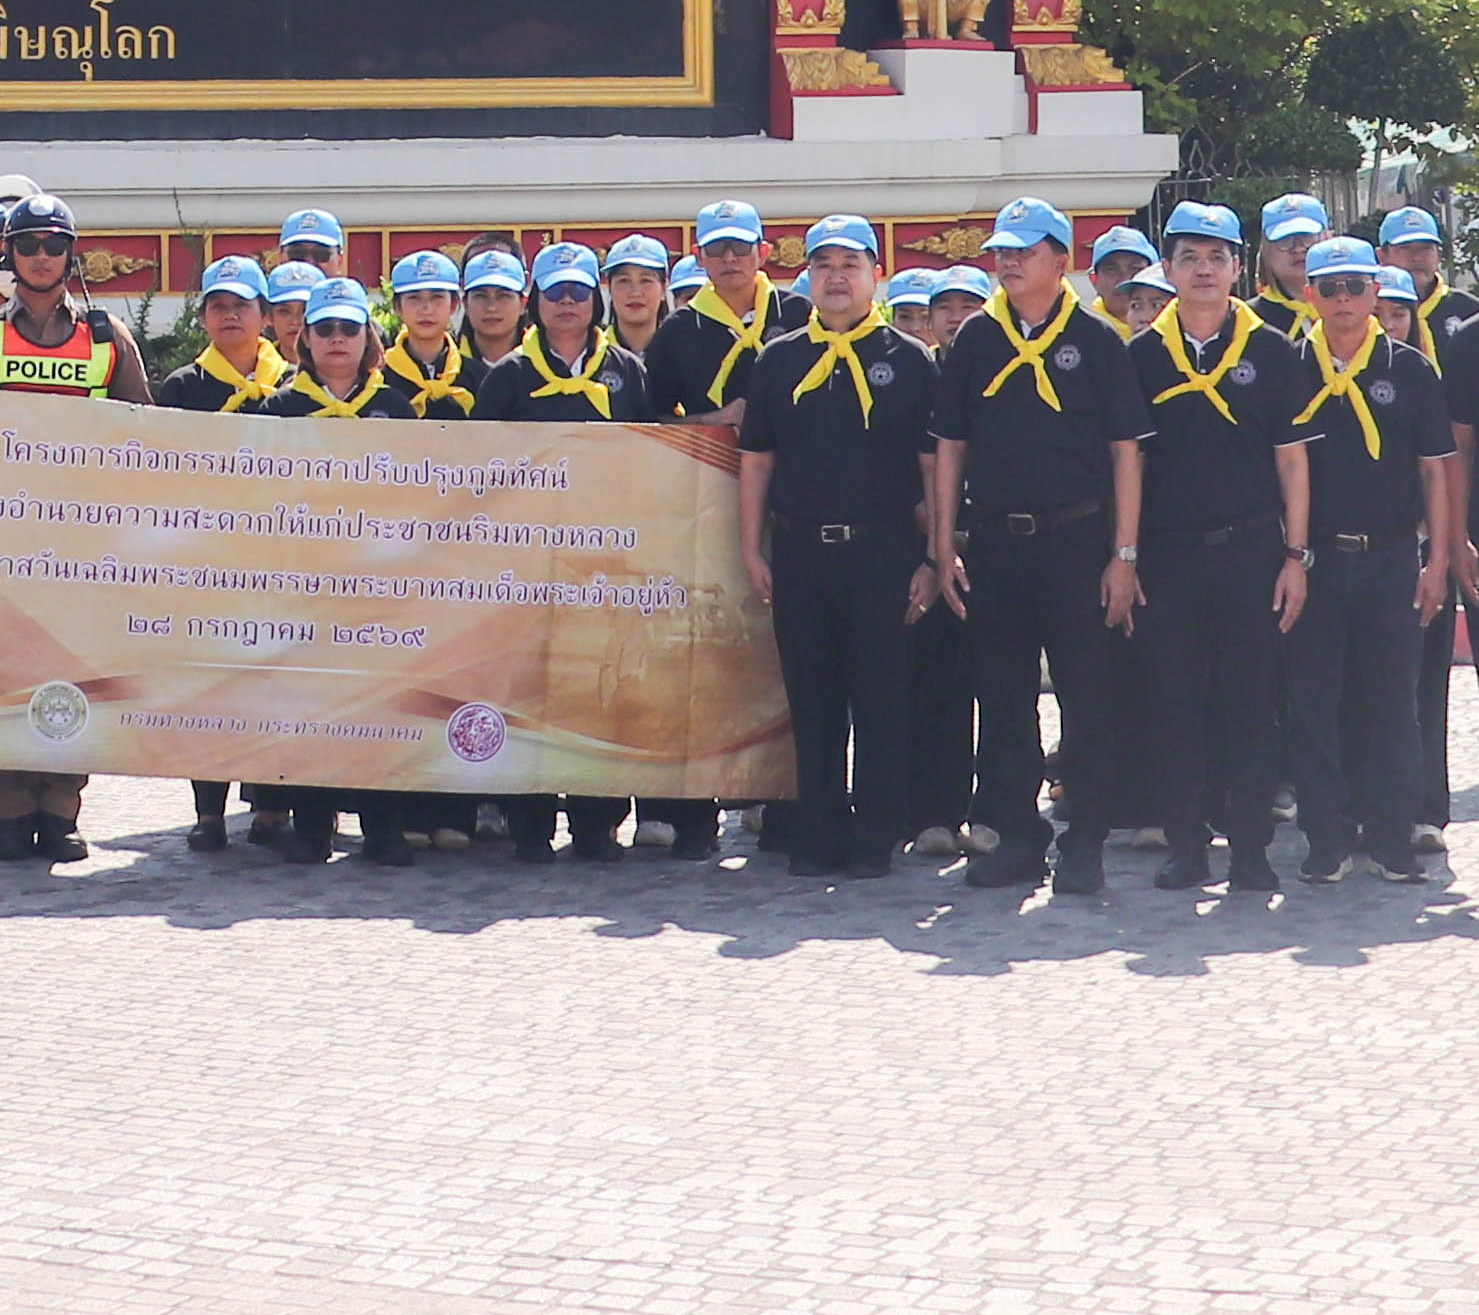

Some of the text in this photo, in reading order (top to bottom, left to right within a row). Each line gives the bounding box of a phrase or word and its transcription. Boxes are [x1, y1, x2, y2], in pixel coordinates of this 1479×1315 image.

[6, 360, 87, 382] POLICE
[0, 429, 570, 496] โครงการกิจกรรมจิตอาสาปรับปรุงภูมิทัศน์
[127, 613, 426, 650] ๒๘ กรกฎาคม ๒๕๖๙
[119, 709, 424, 742] กรมทางหลวง กระทรวงคมนาคม
